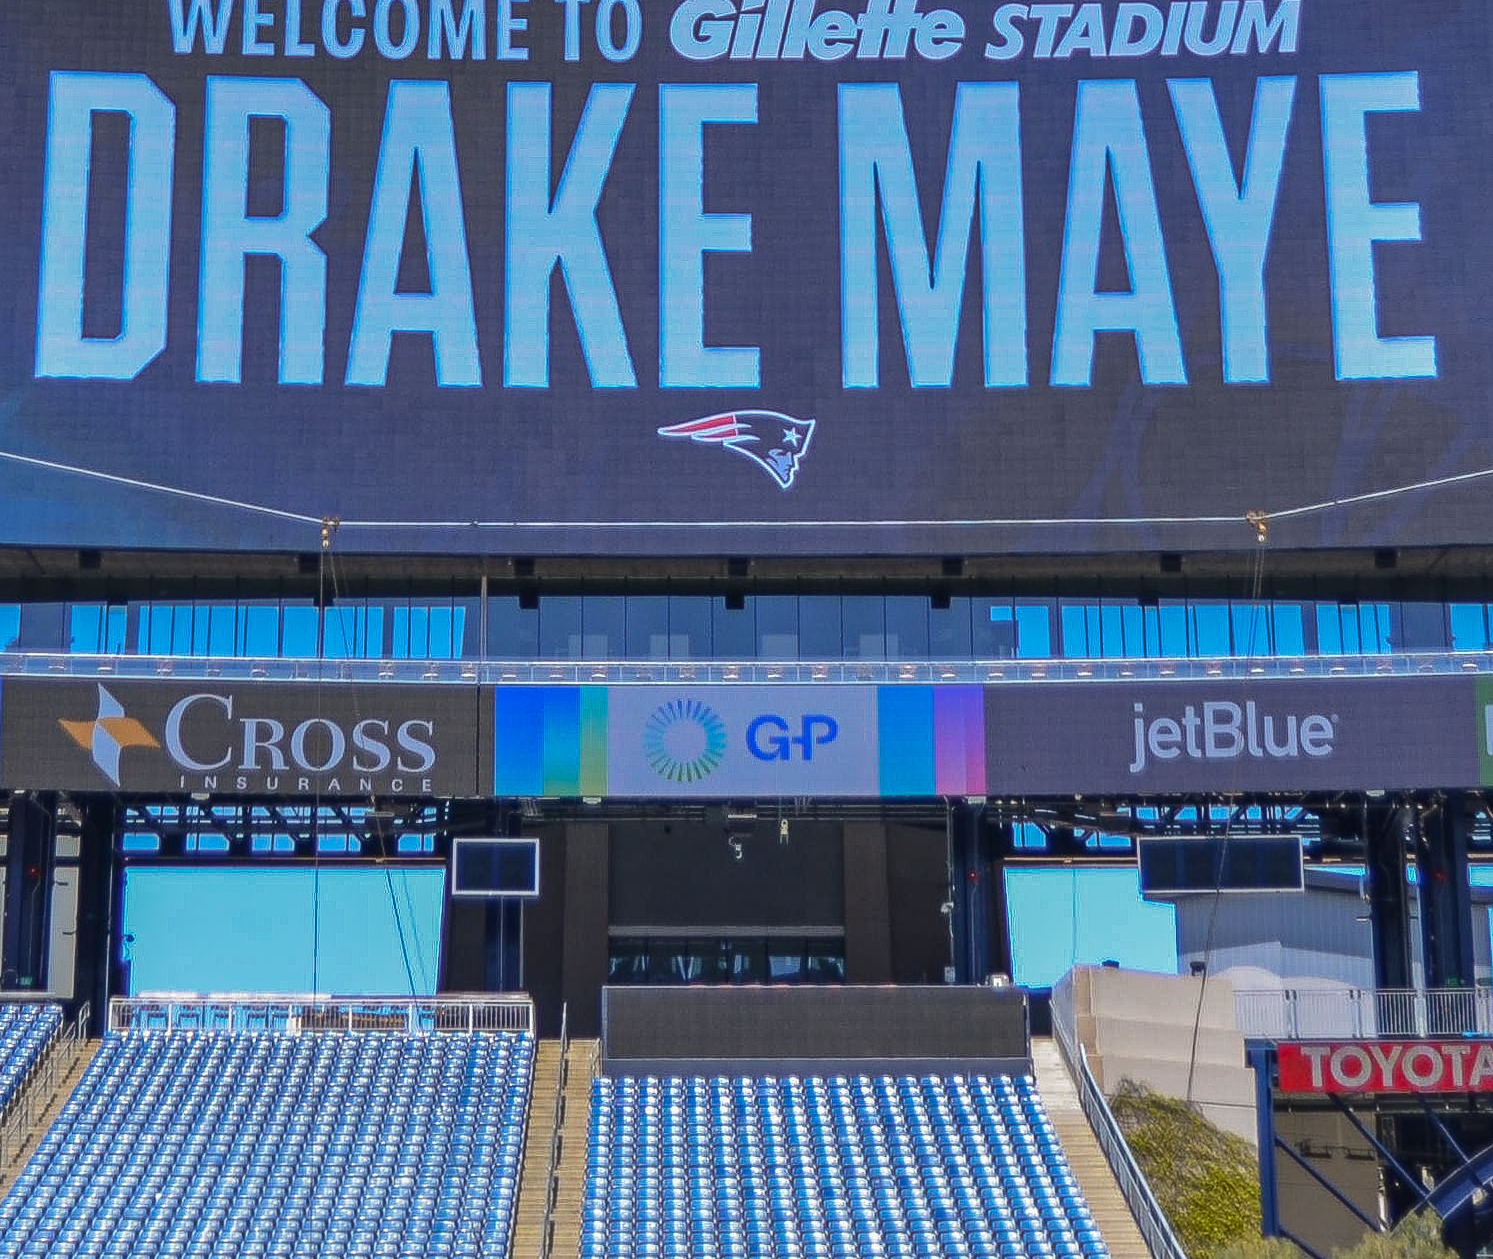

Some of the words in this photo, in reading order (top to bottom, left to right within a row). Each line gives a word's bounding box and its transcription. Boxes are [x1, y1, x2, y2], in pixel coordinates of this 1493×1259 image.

[34, 70, 760, 388] DRAKE
[837, 71, 1438, 389] MAYE
[1129, 700, 1334, 773] jetBlue
[179, 775, 433, 791] INSURANCE
